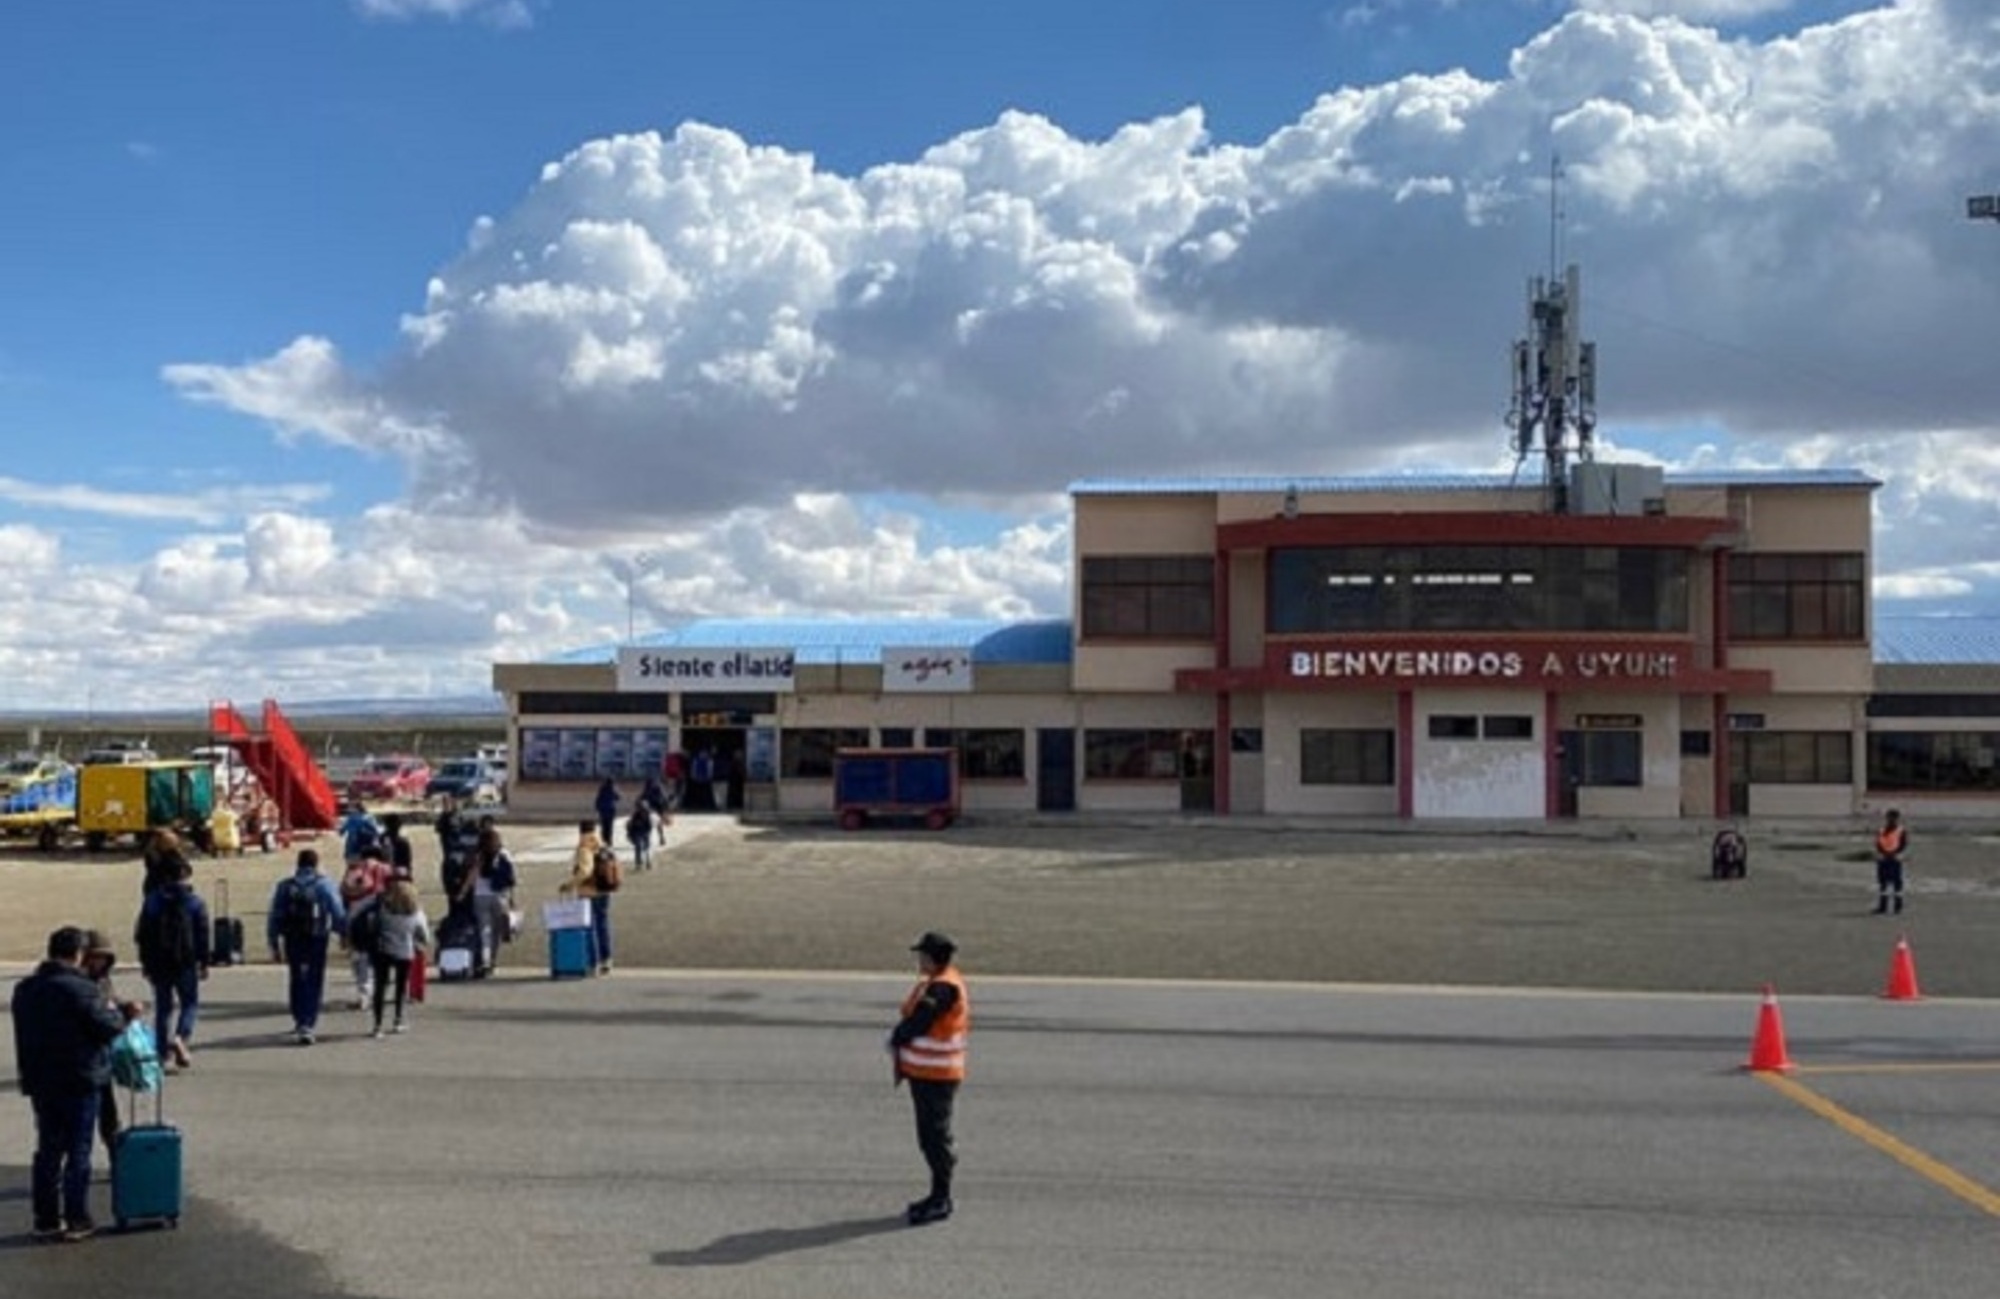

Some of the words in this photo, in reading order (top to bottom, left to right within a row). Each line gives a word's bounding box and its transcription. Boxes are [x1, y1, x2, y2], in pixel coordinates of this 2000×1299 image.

[639, 655, 716, 677] Siente
[1291, 652, 1523, 676] BIENVENIDOS
[1541, 652, 1564, 676] A
[1578, 652, 1677, 676] UYUNI
